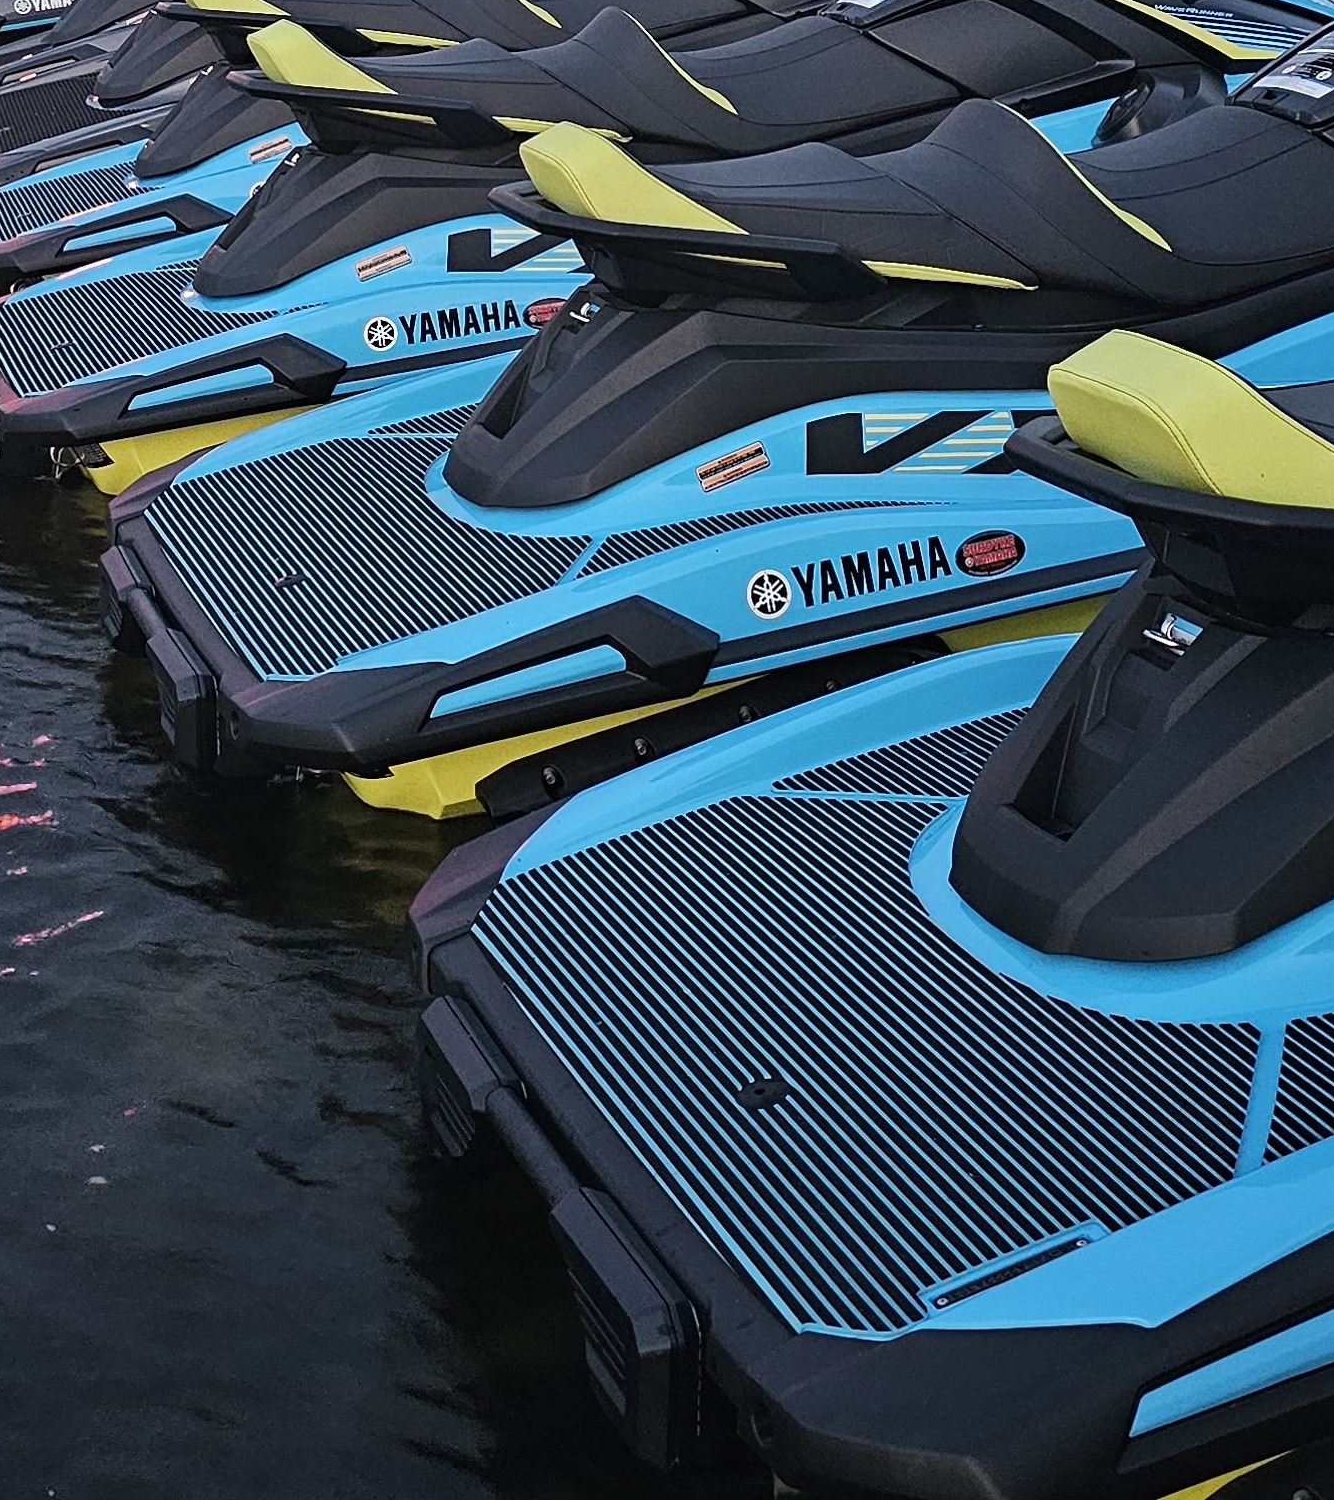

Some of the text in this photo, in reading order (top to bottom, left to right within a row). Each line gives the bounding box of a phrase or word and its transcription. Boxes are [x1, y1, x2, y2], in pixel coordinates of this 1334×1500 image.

[398, 299, 521, 345] YAMAHA
[962, 534, 1015, 558] SURDYKE
[973, 546, 1018, 567] YAMAHA
[790, 535, 953, 608] YAMAHA
